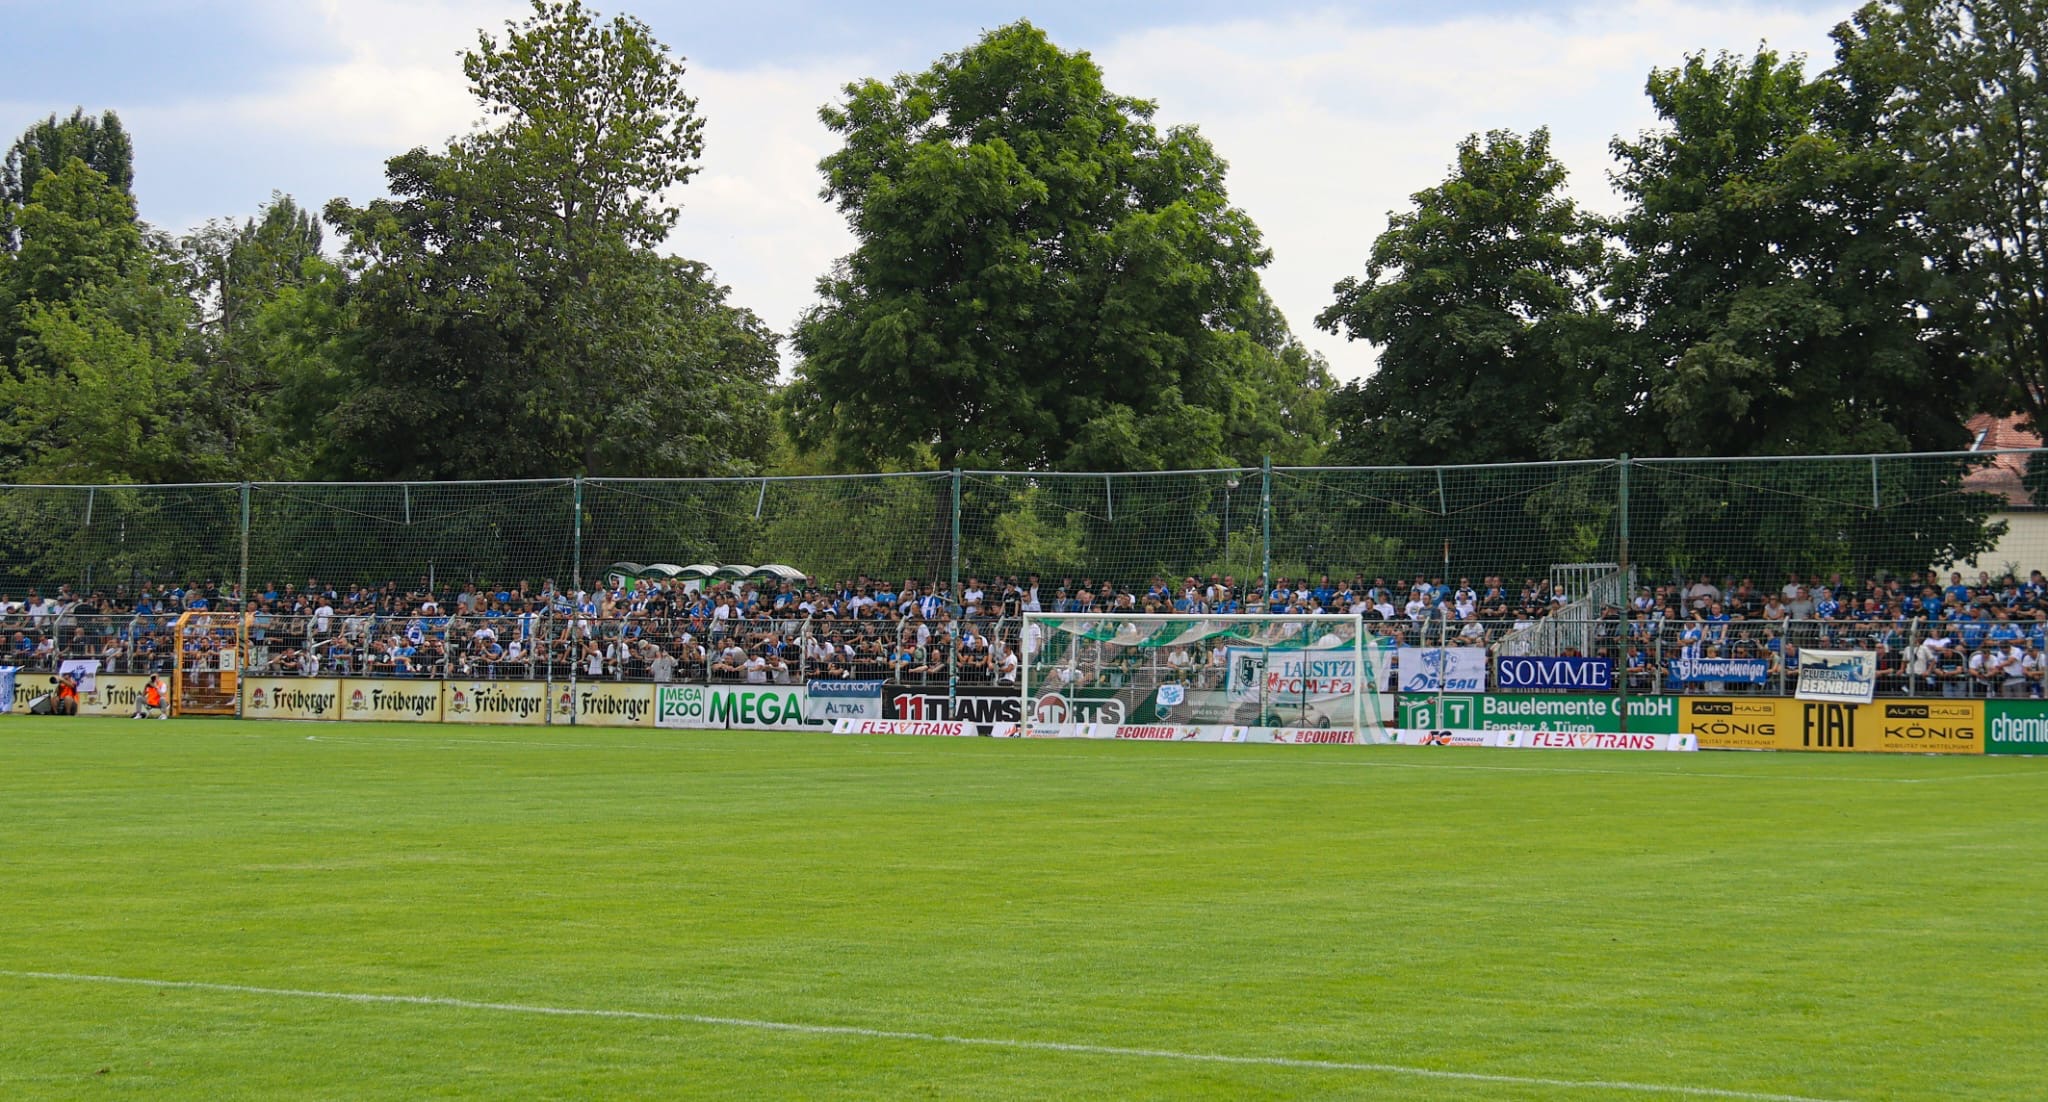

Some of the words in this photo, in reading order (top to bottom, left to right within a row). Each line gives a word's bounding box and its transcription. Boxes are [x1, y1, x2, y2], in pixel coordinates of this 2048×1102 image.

[1500, 660, 1608, 686] SOMME
[1802, 669, 1849, 680] CLUBFANS
[666, 688, 701, 701] MEGA
[1801, 680, 1869, 694] BERNBURG
[272, 687, 335, 714] Freiberger
[372, 689, 437, 716] Freiberger
[473, 690, 541, 718] Freiberger
[581, 692, 650, 720] Freiberger
[1483, 697, 1606, 716] Bauelemente
[665, 702, 702, 717] ZOO
[1450, 704, 1465, 724] T
[1124, 726, 1174, 739] COURIER
[1483, 720, 1535, 732] Fenster
[1553, 720, 1595, 733] Türen
[1691, 720, 1775, 735] KÖNIG
[1803, 703, 1859, 747] FIAT
[1884, 723, 1974, 739] KÖNIG
[1303, 731, 1355, 744] COURIER
